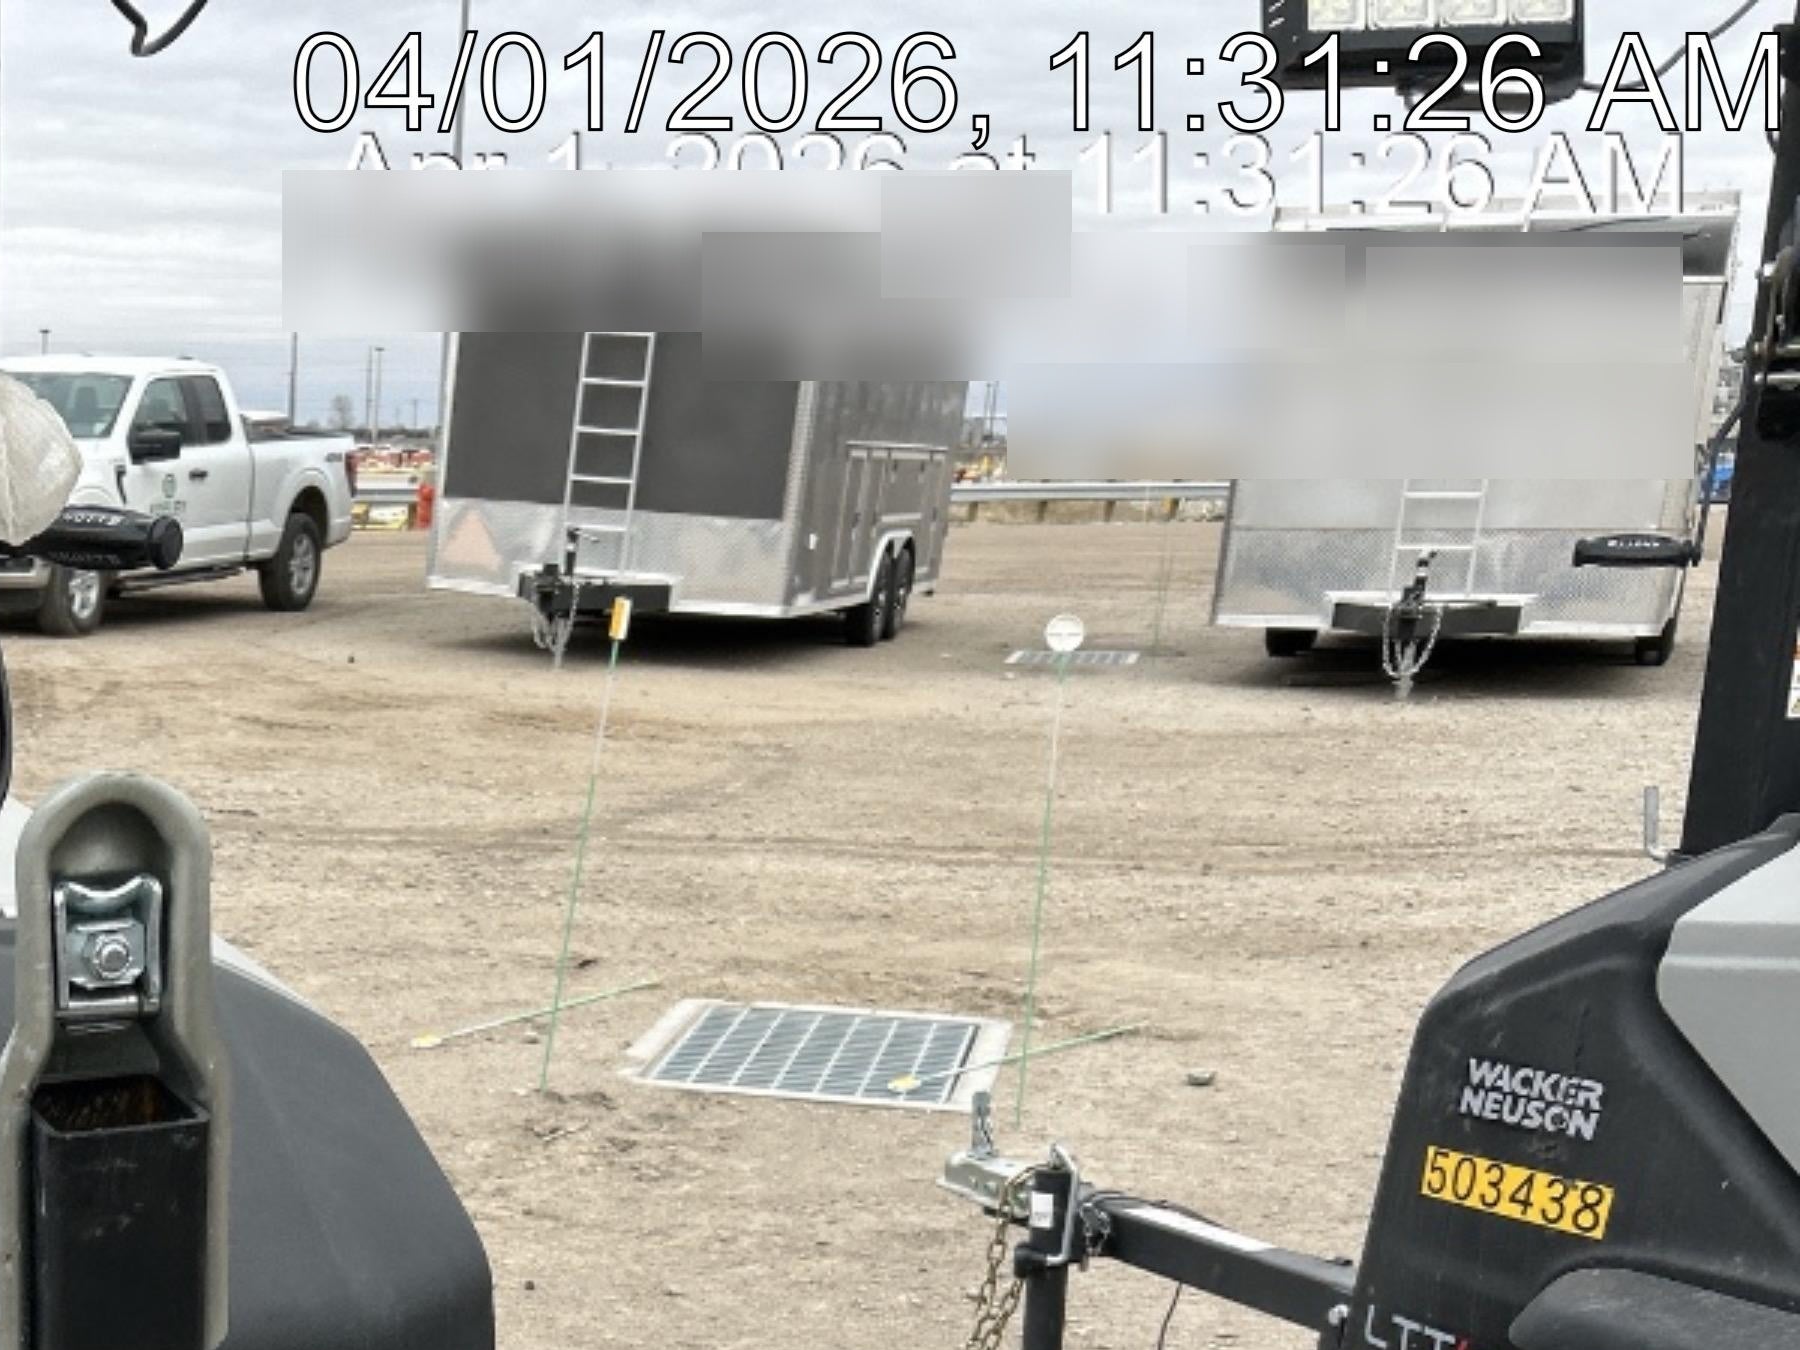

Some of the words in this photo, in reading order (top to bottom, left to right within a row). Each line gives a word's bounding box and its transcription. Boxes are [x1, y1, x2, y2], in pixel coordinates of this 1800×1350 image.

[1468, 1057, 1603, 1111] WACKER
[1458, 1087, 1601, 1142] NEUSON
[1426, 1149, 1606, 1234] 503438
